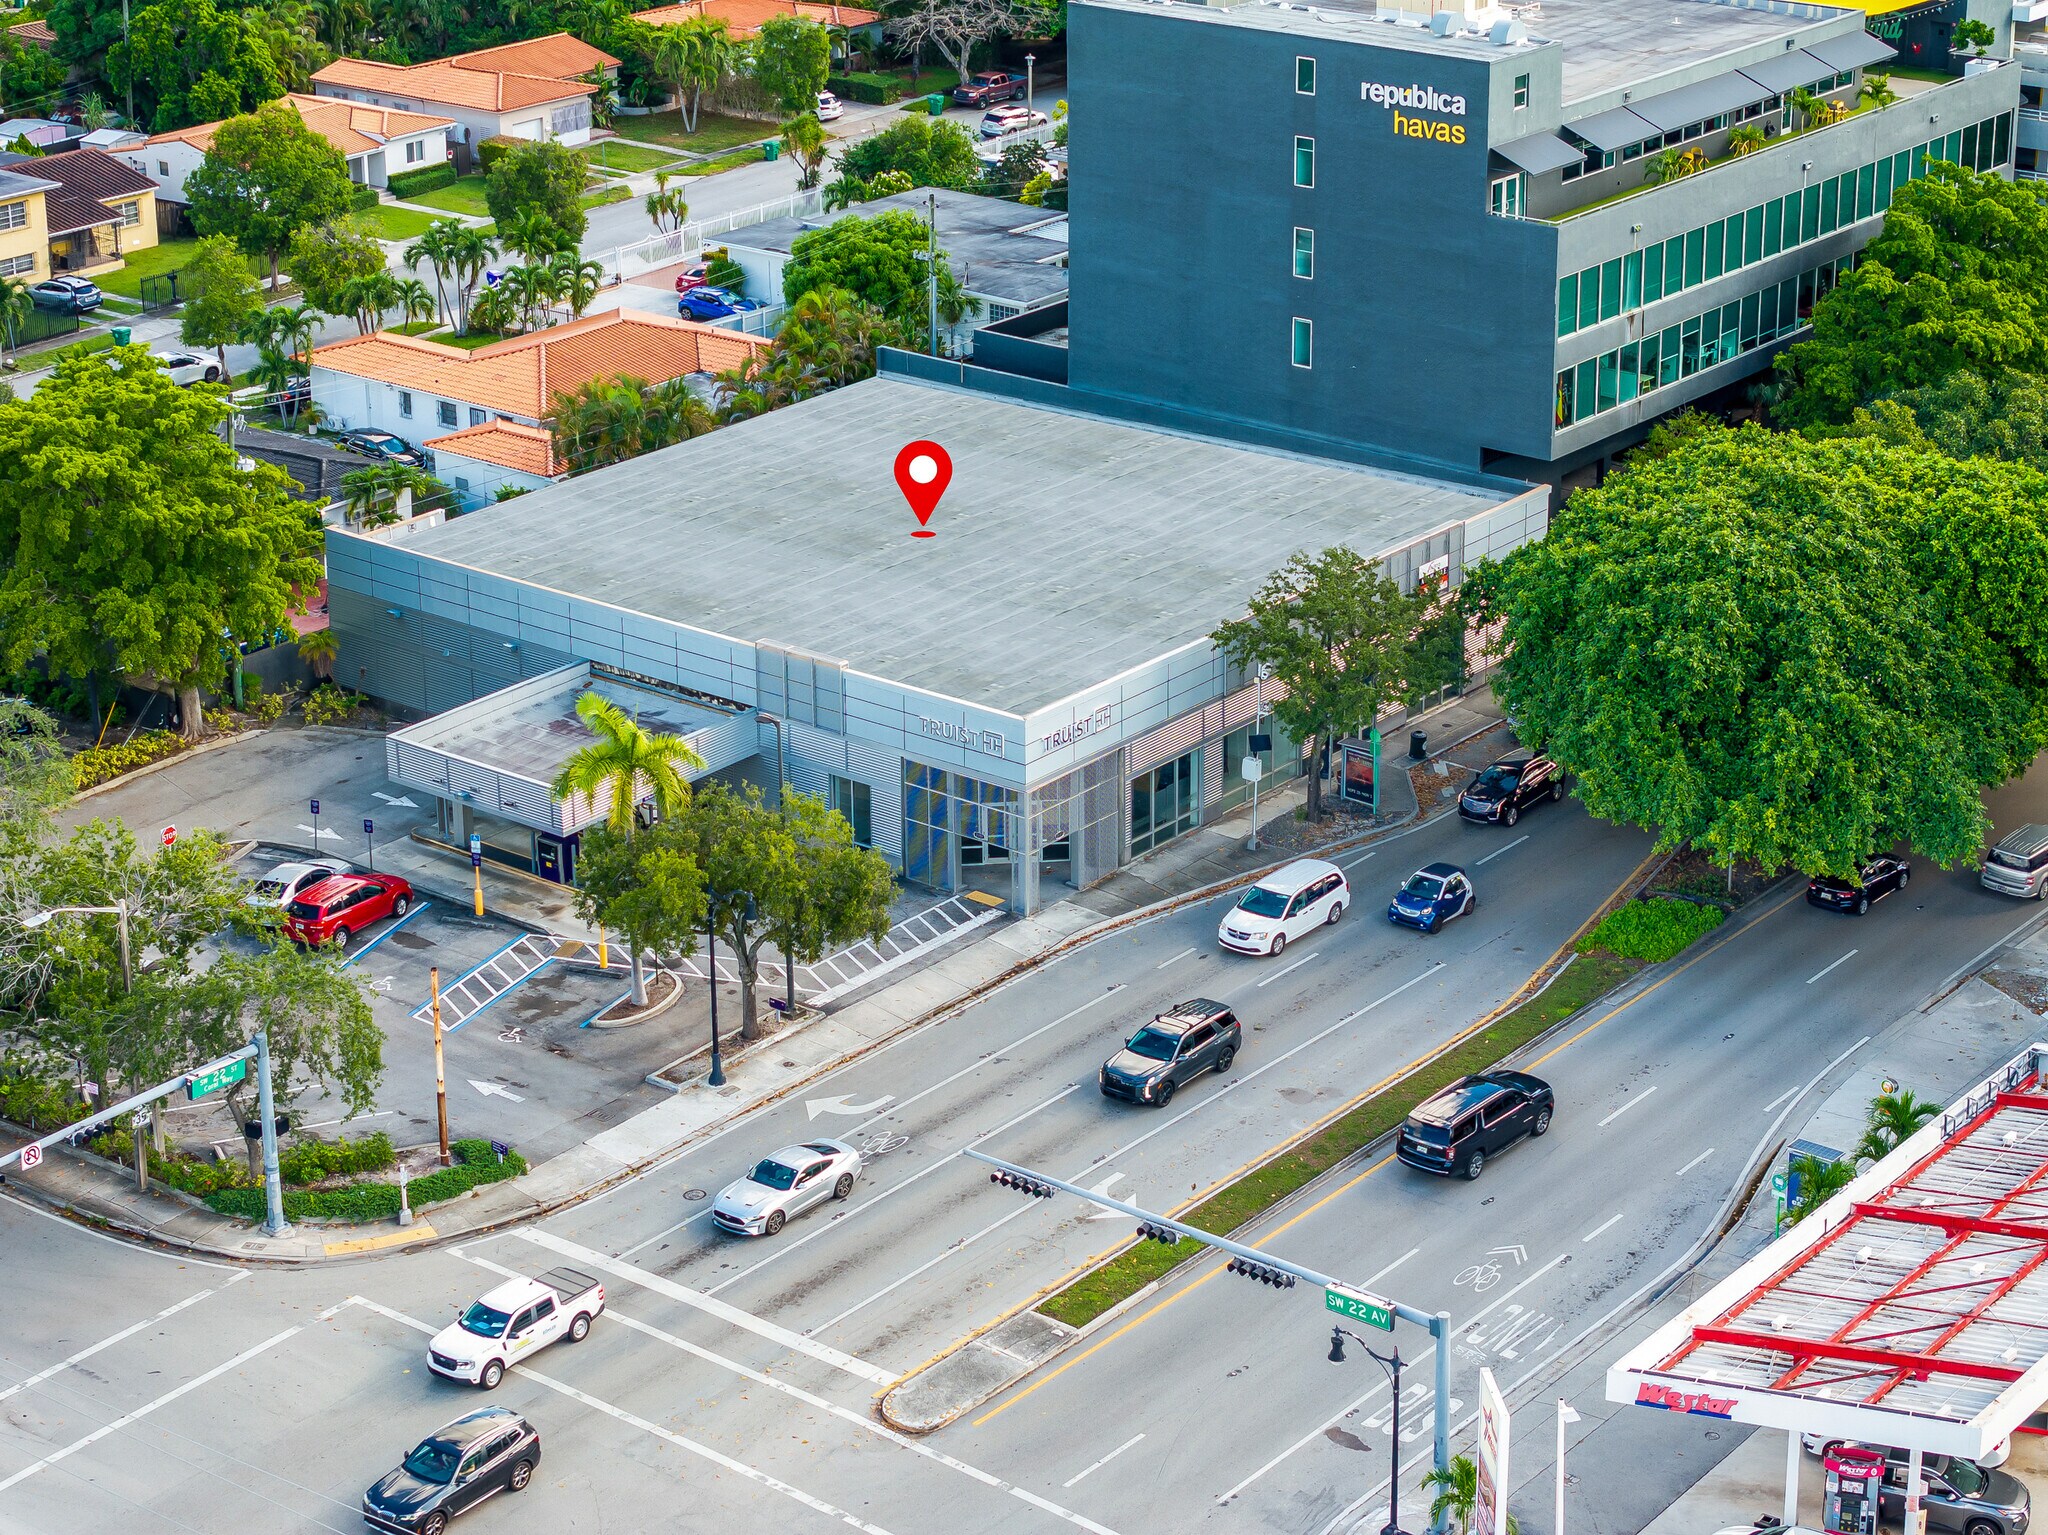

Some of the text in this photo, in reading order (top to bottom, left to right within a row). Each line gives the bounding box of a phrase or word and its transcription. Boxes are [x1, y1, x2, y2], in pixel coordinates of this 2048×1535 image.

[1393, 110, 1466, 144] havas
[919, 716, 981, 746] TRUIST
[1043, 716, 1094, 752] TRUIST
[162, 830, 177, 842] STOP
[200, 1064, 238, 1086] SW 22 ST
[204, 1081, 219, 1092] Coral
[1329, 1295, 1386, 1324] SW 22 AV
[1637, 1382, 1738, 1415] Westar
